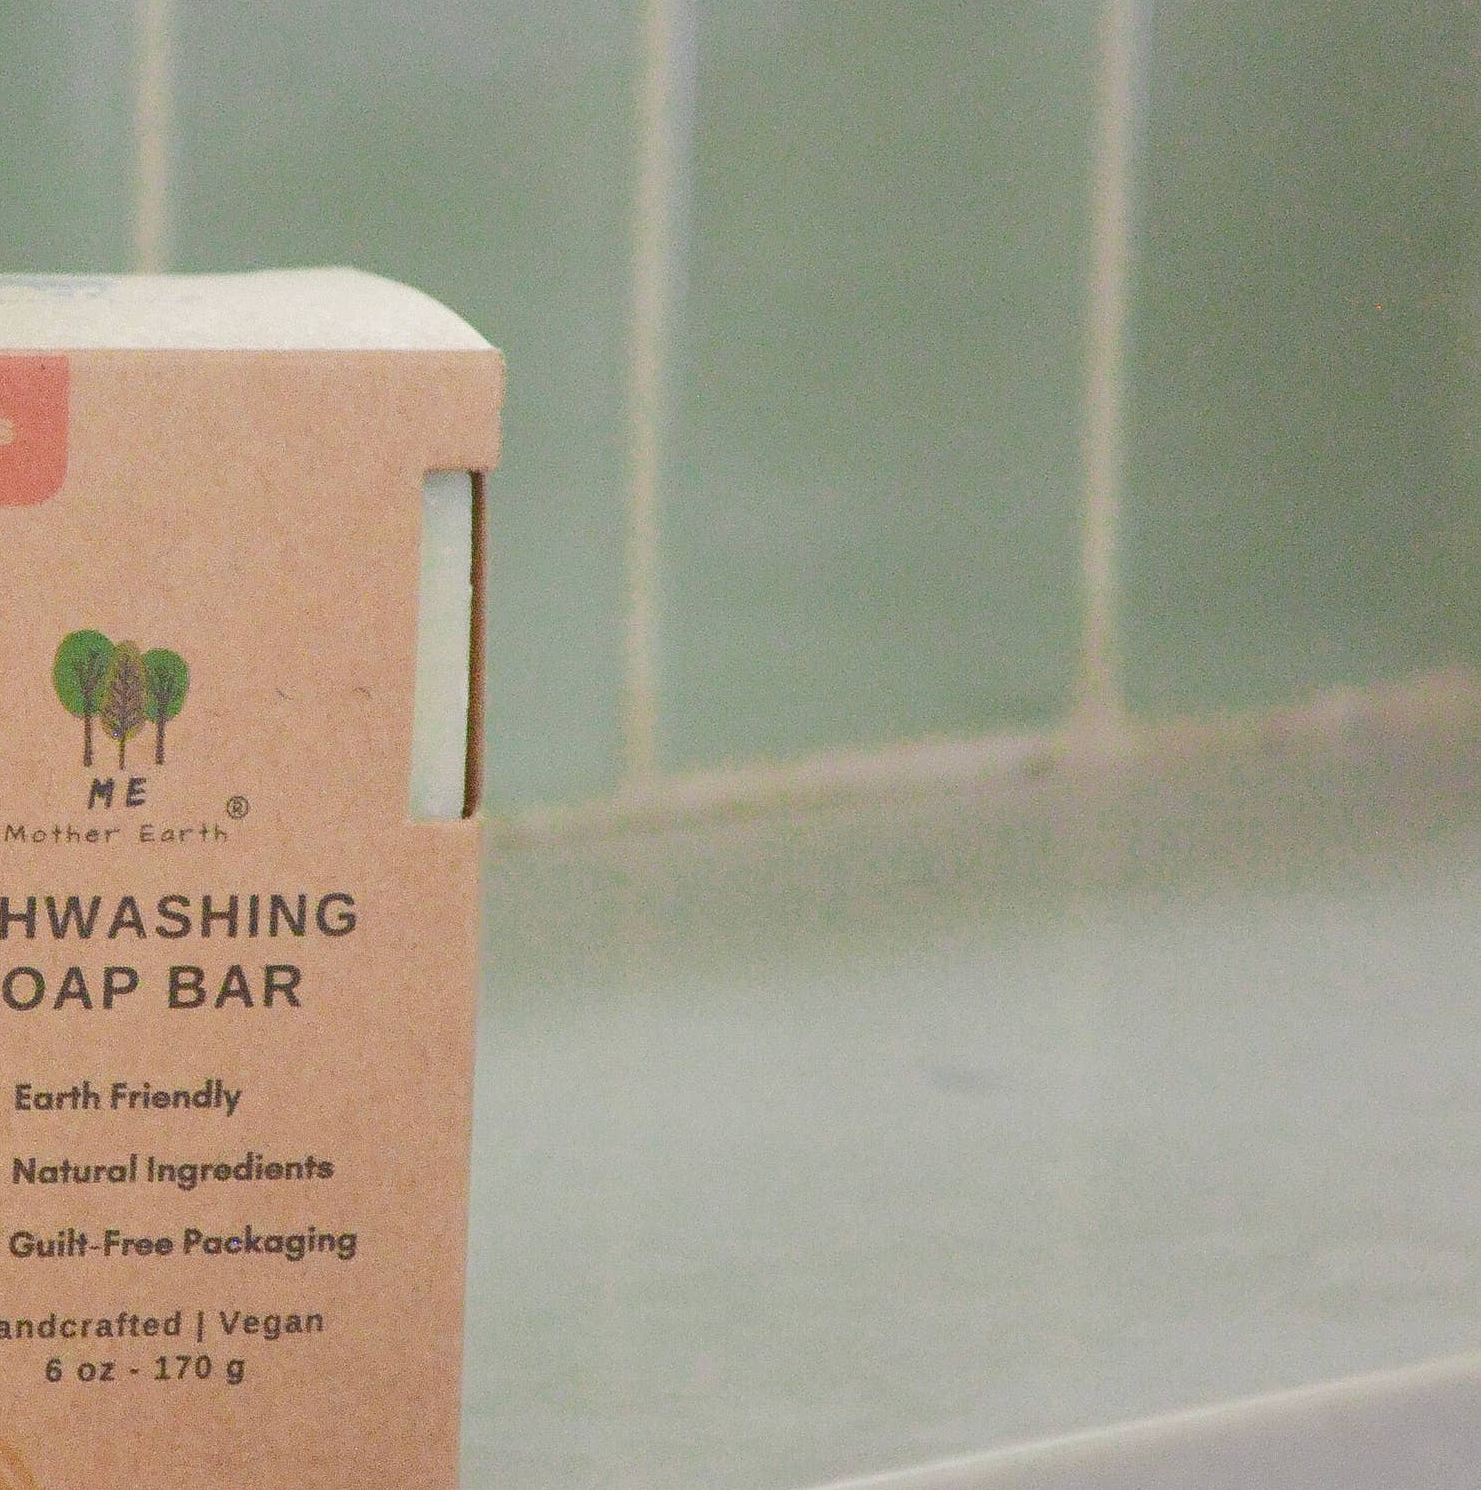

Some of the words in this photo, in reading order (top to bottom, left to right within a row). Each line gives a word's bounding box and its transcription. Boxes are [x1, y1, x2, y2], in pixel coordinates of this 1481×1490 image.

[87, 777, 147, 810] ME
[3, 824, 120, 844] Mother
[139, 822, 228, 844] Earth
[167, 964, 304, 1009] BAR
[13, 1081, 102, 1111] Earth
[111, 1079, 242, 1117] Friendly
[12, 1155, 138, 1187] Natural
[147, 1153, 335, 1189] Ingredients
[7, 1229, 175, 1261] Guilt-Free
[184, 1226, 358, 1262] Packaging
[218, 1308, 325, 1341] Vegan
[45, 1359, 63, 1383] 6
[77, 1360, 116, 1382] oz
[154, 1354, 213, 1381] 170
[225, 1357, 246, 1385] g
